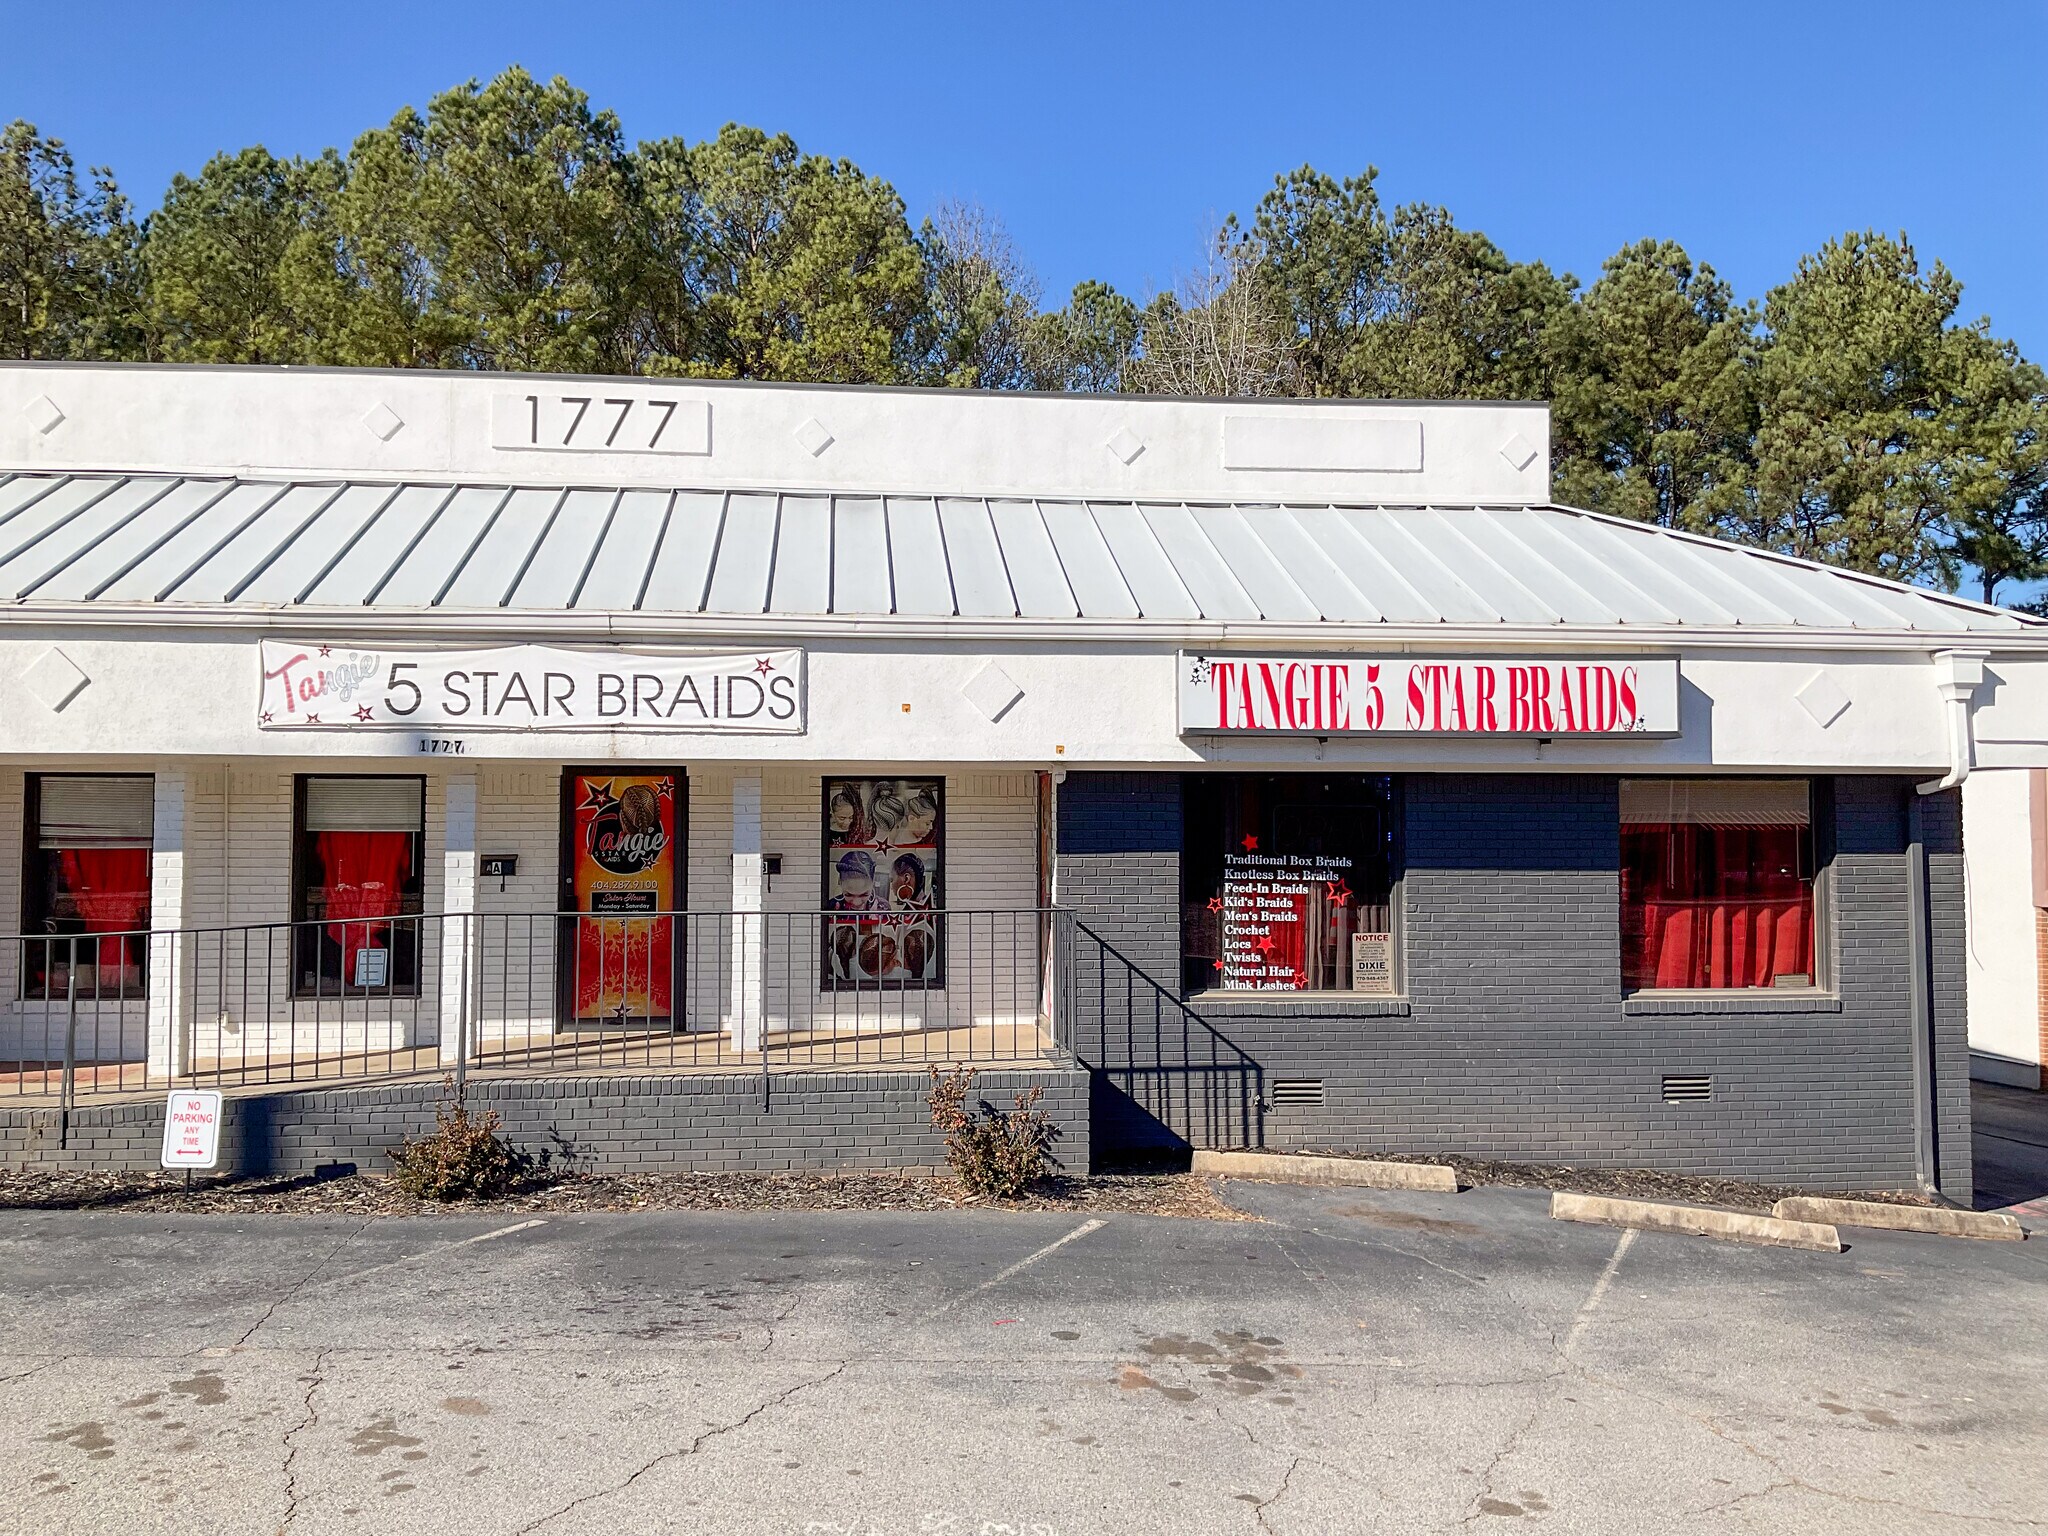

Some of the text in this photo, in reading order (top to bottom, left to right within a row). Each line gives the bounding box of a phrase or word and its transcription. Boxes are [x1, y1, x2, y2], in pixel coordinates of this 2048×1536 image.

[525, 396, 678, 448] 1777
[265, 652, 795, 719] Tangie 5 STAR BRAIDS
[1211, 663, 1637, 732] TANGIE 5 STAR BRAIDS
[420, 740, 463, 754] 1777
[580, 813, 670, 862] Tangie
[1224, 854, 1352, 867] Traditional Box Braids
[1224, 869, 1339, 882] Knotless Box Braids
[591, 881, 658, 890] 404.287.9100
[1224, 883, 1309, 894] Feed-In Braids
[1256, 897, 1293, 908] Braids
[1260, 911, 1298, 922] Braids
[1224, 925, 1270, 935] Crochet
[1355, 934, 1389, 942] NOTICE
[1224, 939, 1251, 949] Locs
[1224, 952, 1261, 962] Twists
[1358, 961, 1386, 970] DIXIE
[1224, 966, 1295, 977] Natural Hair
[1224, 980, 1296, 990] Mink Lashes
[187, 1101, 201, 1111] NO
[173, 1113, 213, 1123] PARKING
[184, 1126, 200, 1134] ANY
[182, 1137, 199, 1145] TIME
